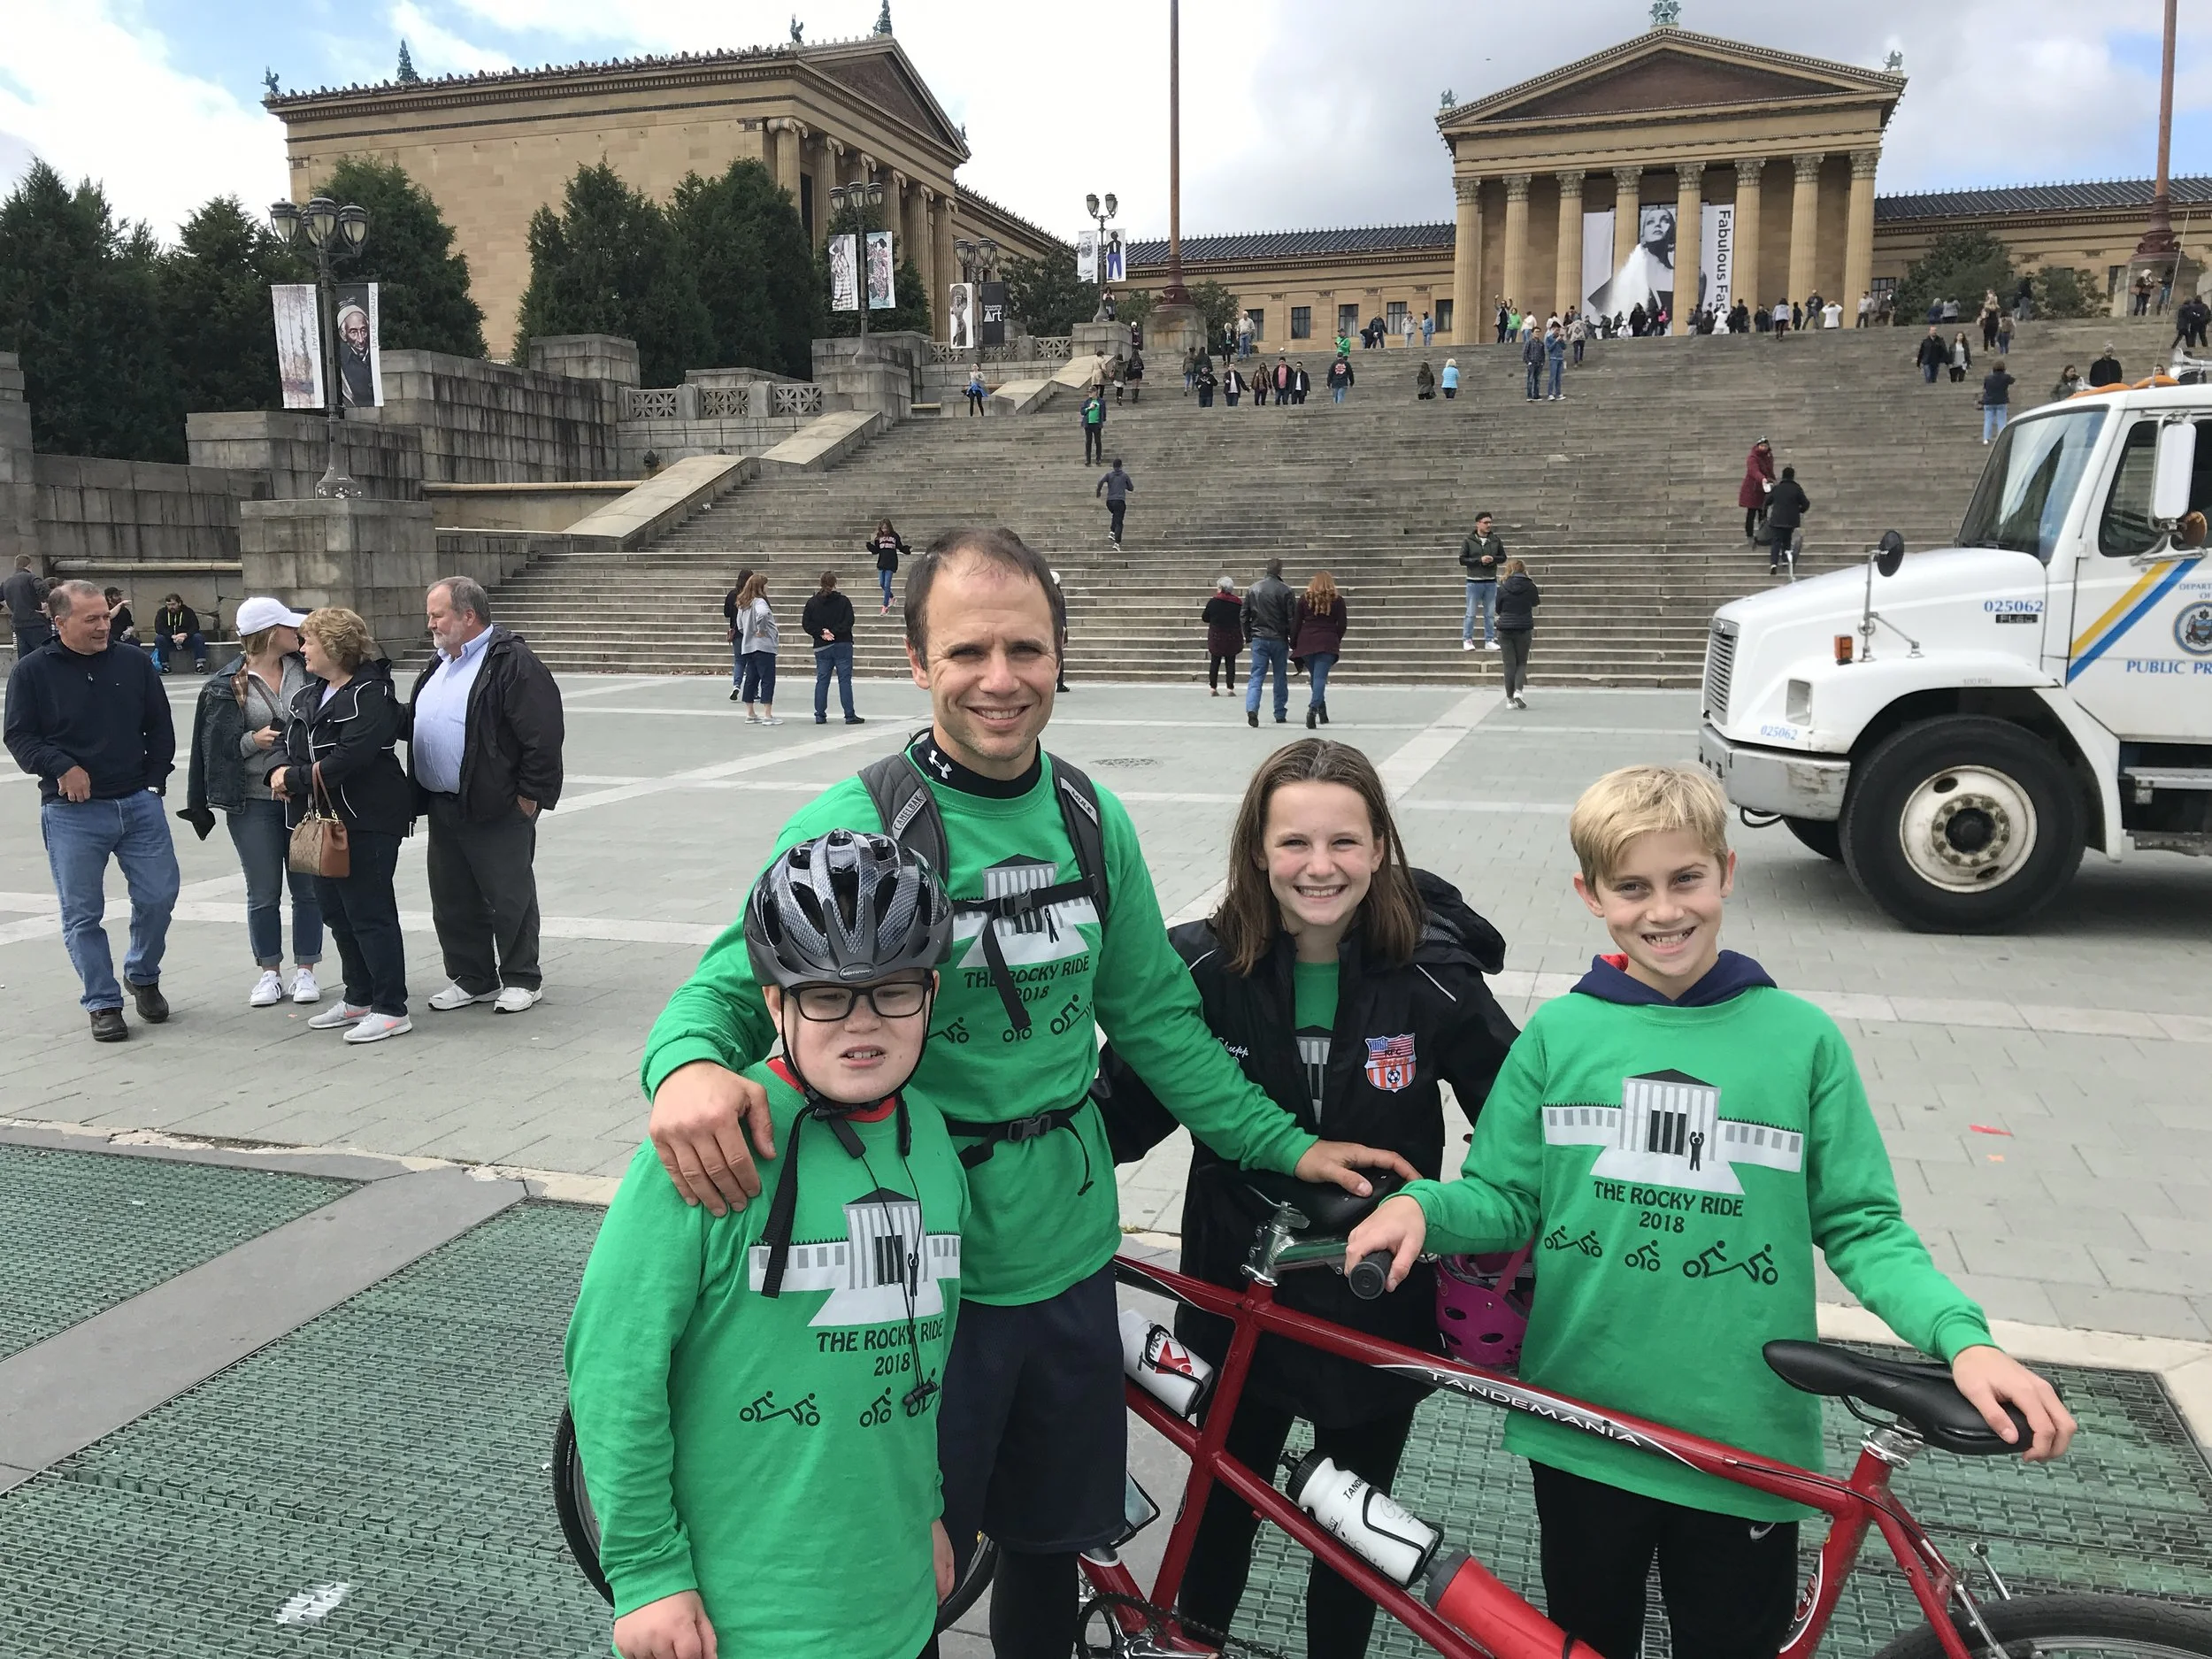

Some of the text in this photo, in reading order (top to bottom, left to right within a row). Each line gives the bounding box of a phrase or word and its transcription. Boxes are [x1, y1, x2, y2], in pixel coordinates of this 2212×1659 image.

[1715, 210, 1732, 314] Fabulous Fas
[307, 292, 317, 336] European
[369, 291, 378, 335] American
[1984, 600, 2044, 613] 025062
[2126, 659, 2186, 674] PUBLIC
[1761, 725, 1799, 741] 025062
[894, 795, 925, 831] CAMELBAK
[1061, 956, 1090, 977] RIDE
[1594, 1180, 1744, 1217] THE ROCKY RIDE
[1639, 1210, 1686, 1233] 2018
[816, 1317, 944, 1353] THE ROCKY RIDE
[873, 1352, 910, 1377] 2018
[1427, 1370, 1641, 1447] TANDEMANIA
